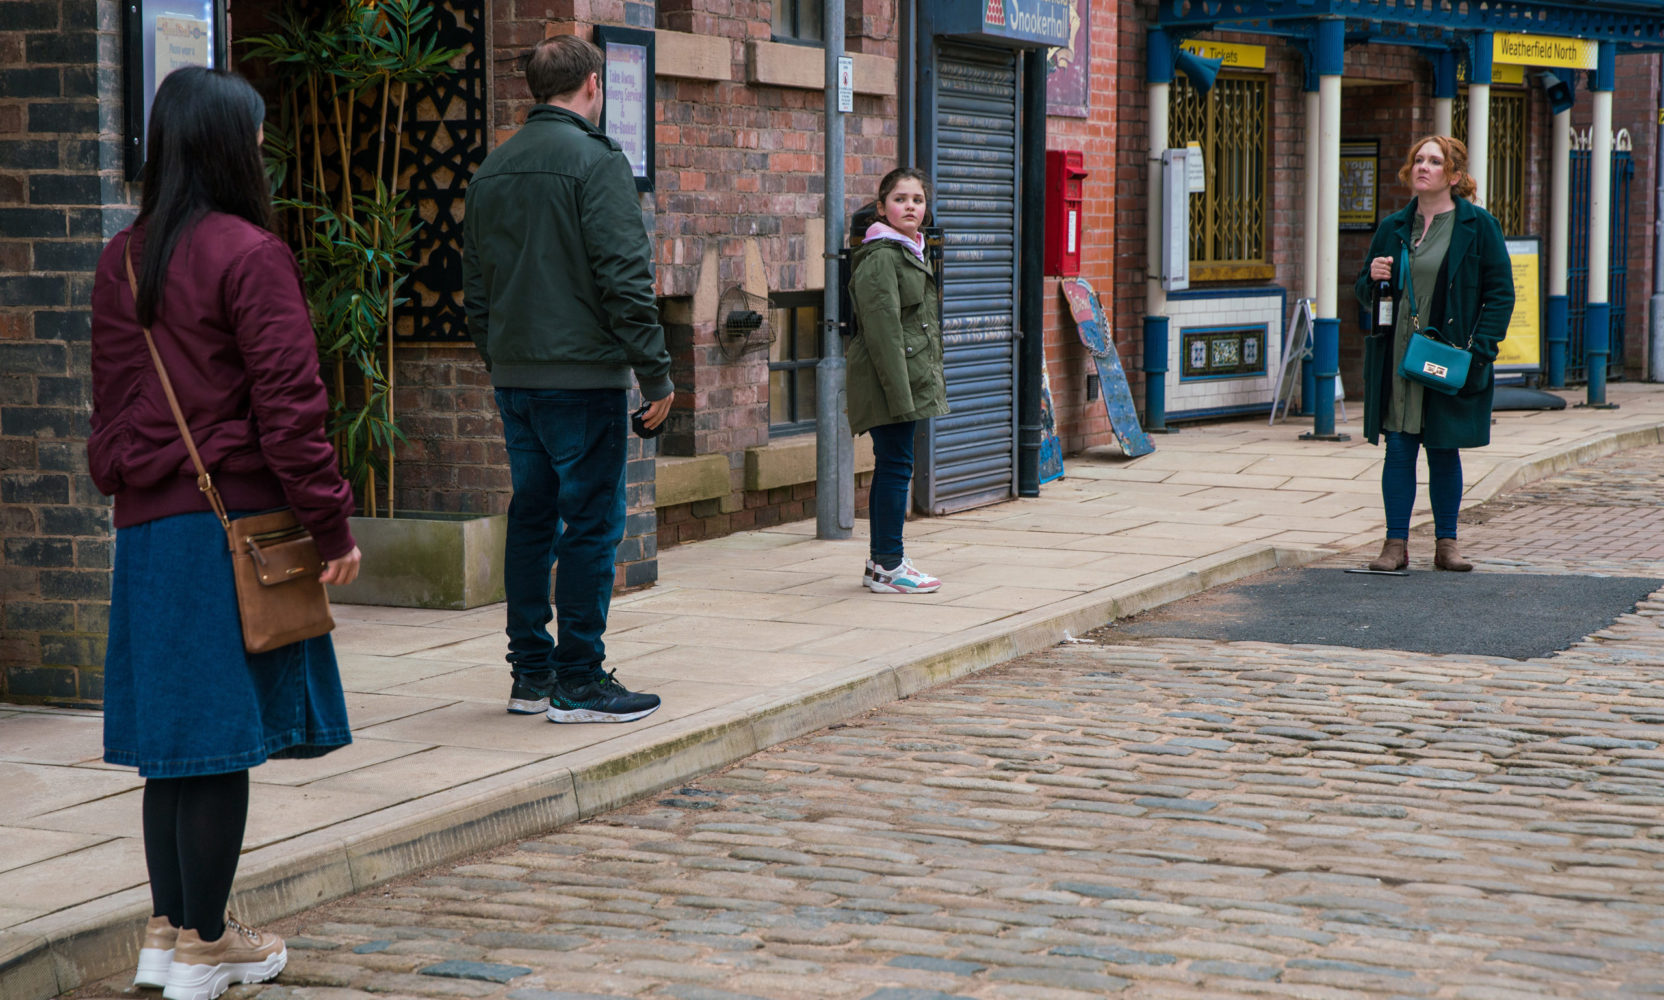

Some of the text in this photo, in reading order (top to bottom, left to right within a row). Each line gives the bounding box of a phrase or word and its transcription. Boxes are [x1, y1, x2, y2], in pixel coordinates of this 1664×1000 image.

[1010, 0, 1067, 38] Snookerhall
[1209, 47, 1238, 63] Tickets
[1500, 38, 1577, 61] Weatherfield North
[608, 69, 620, 84] Take
[606, 86, 624, 104] elivery
